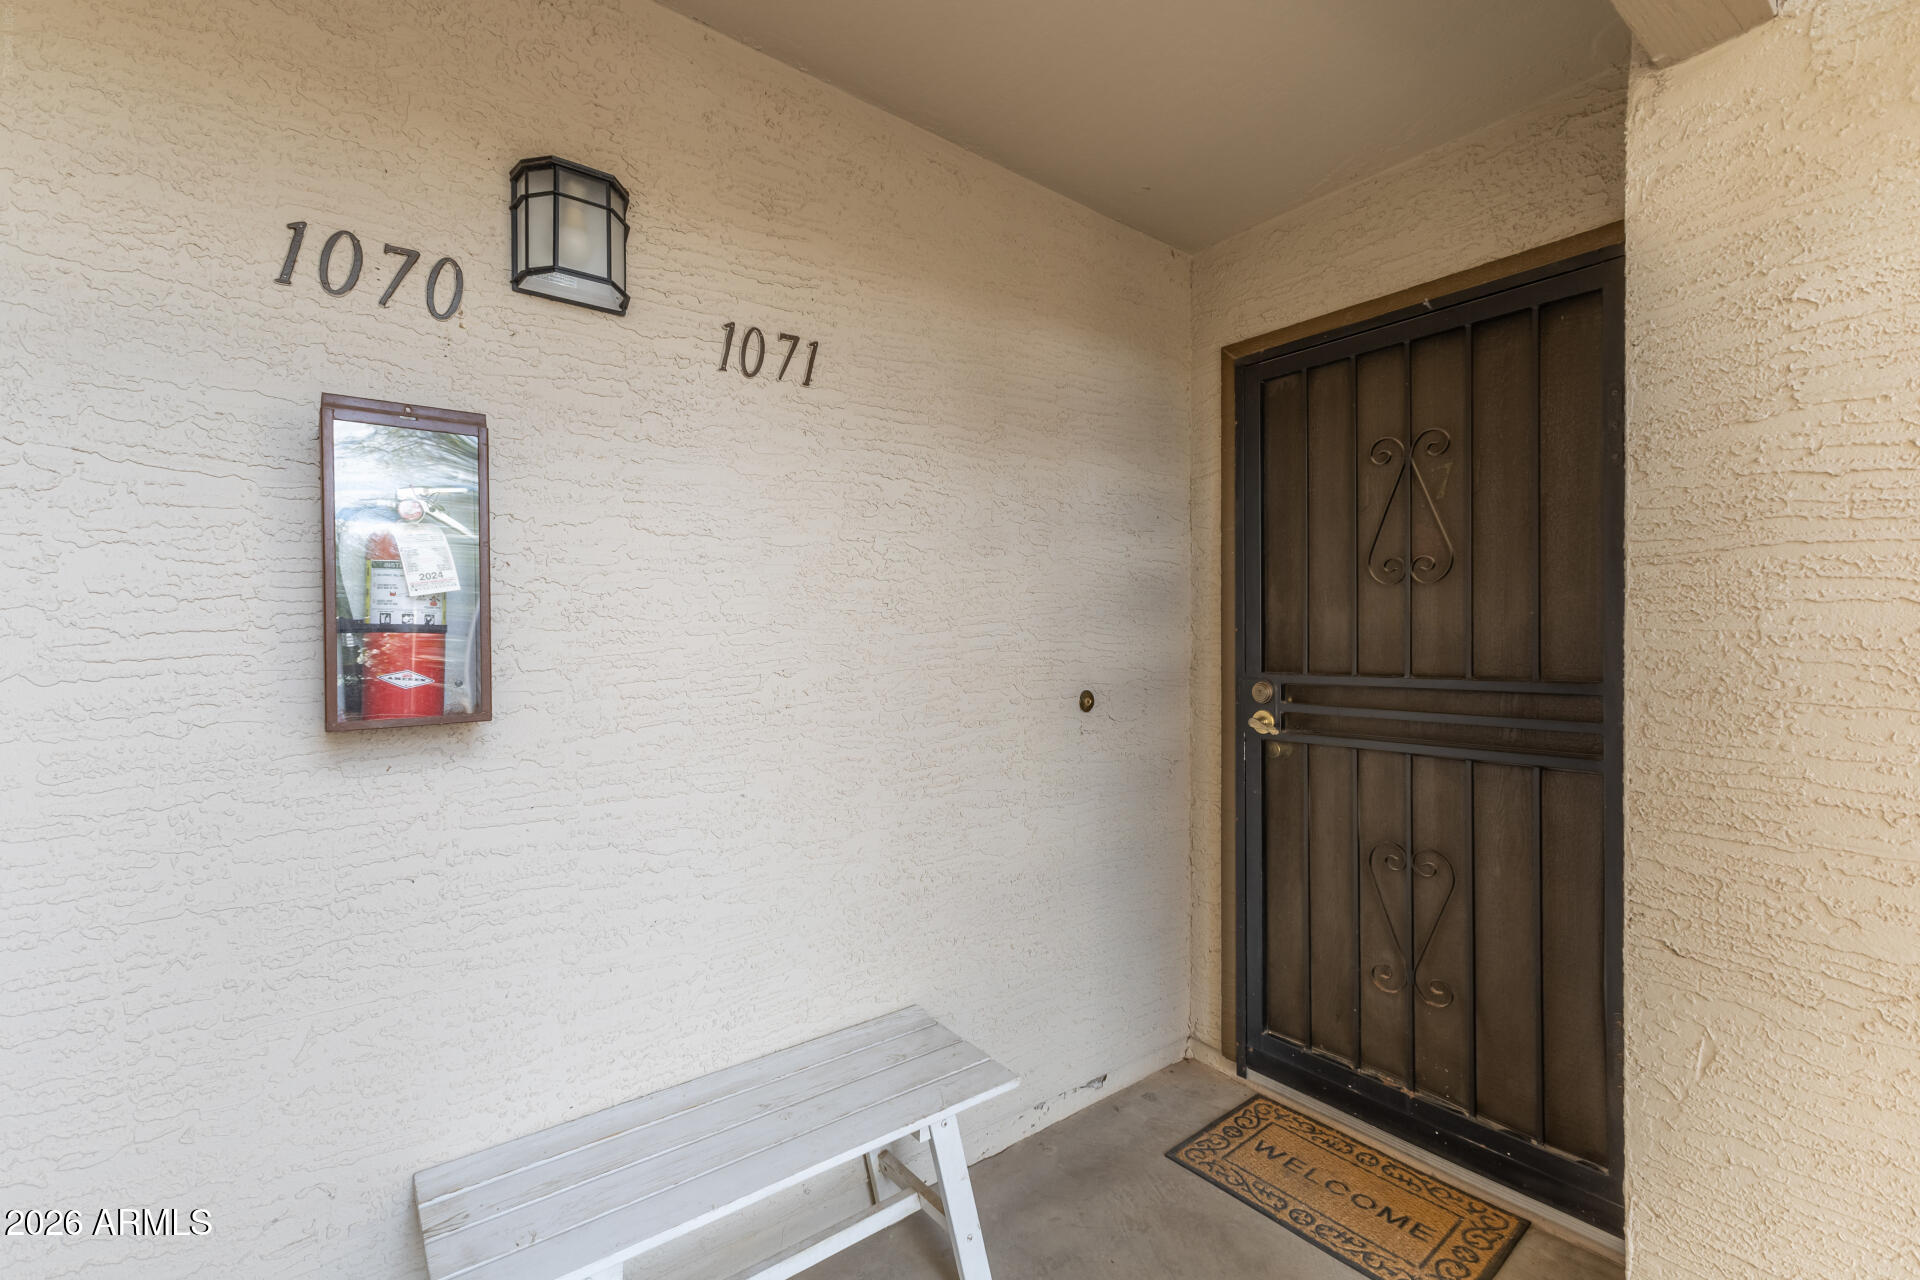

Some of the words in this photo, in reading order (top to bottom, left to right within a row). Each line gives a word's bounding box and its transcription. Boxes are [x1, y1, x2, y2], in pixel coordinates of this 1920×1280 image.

[274, 221, 463, 321] 1070
[718, 321, 819, 387] 1071
[418, 571, 444, 581] 2024
[1254, 1139, 1437, 1243] WELCOME
